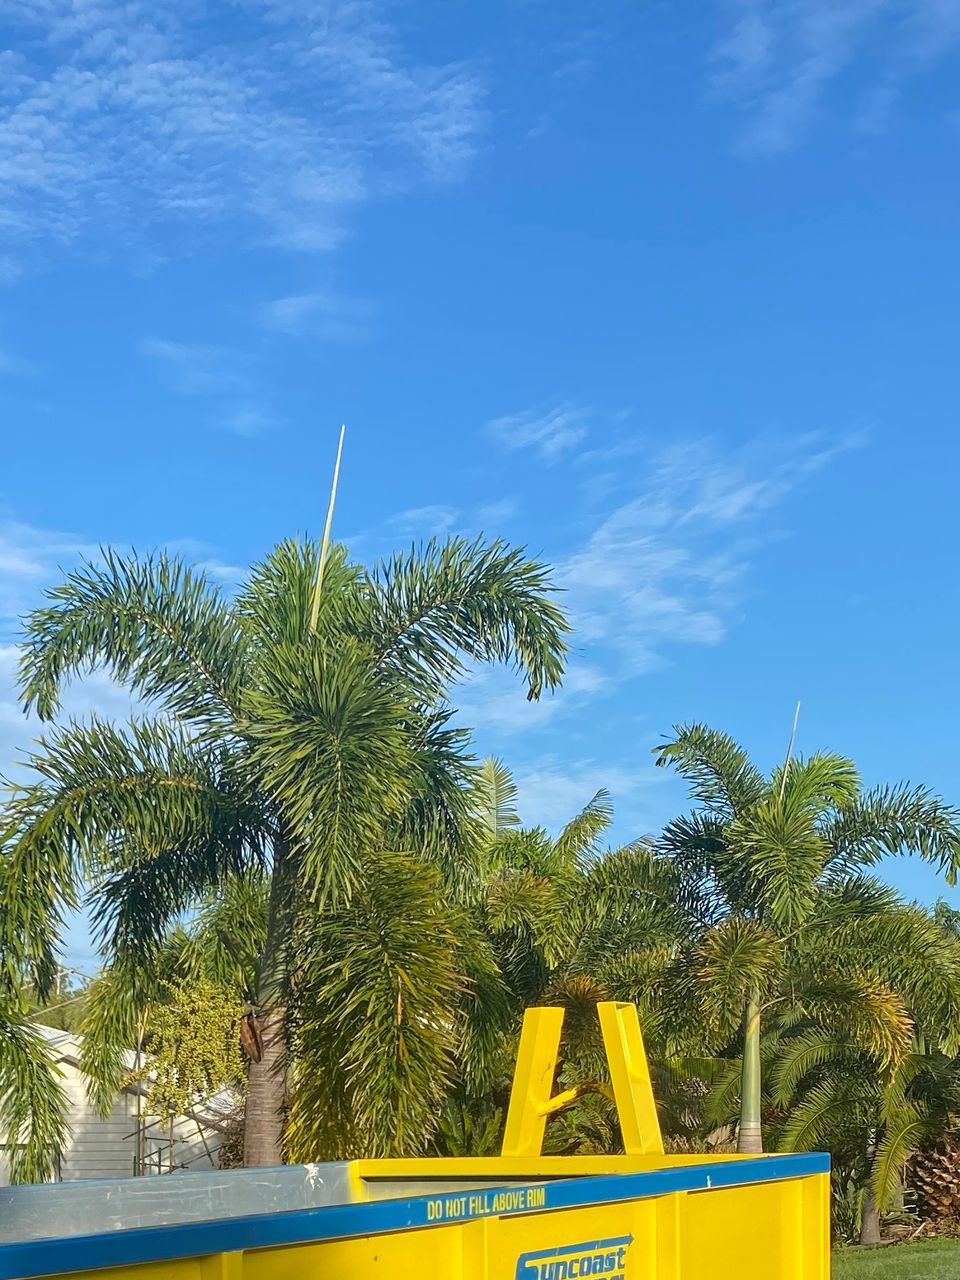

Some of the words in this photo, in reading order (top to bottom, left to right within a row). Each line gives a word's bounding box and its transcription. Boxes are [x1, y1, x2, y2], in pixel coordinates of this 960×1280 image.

[427, 1200, 443, 1220] DO
[446, 1198, 467, 1217] NOT
[469, 1195, 490, 1215] FILL
[493, 1190, 525, 1212] ABOVE
[527, 1187, 545, 1207] RIM
